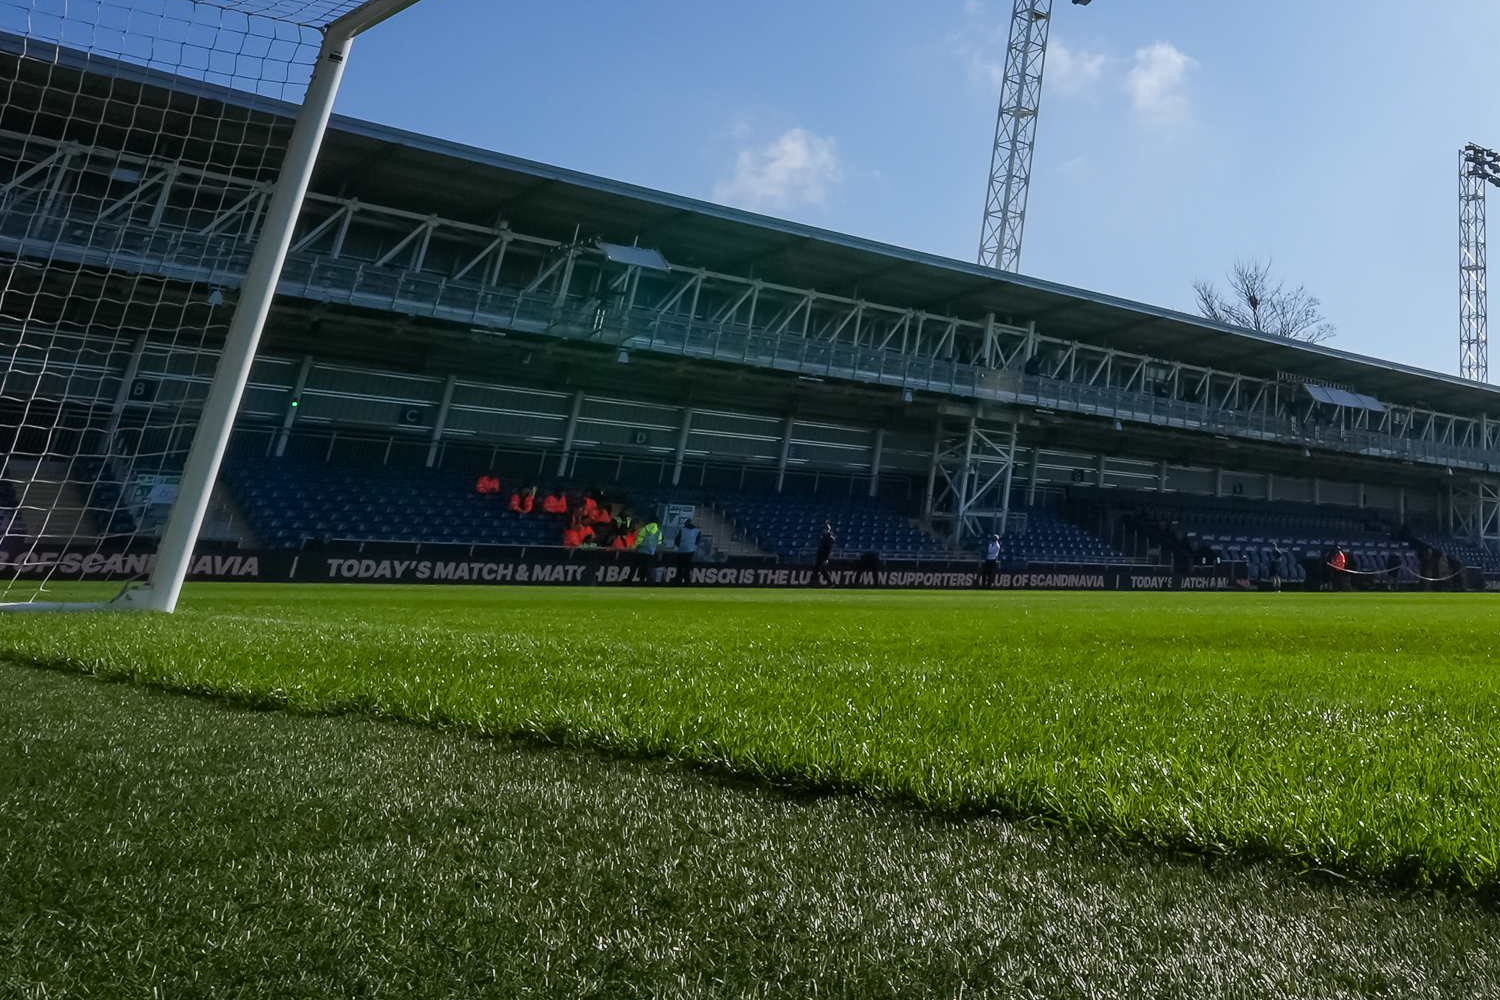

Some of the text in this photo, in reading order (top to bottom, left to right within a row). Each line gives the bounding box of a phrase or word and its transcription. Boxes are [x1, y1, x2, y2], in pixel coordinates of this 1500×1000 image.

[133, 382, 146, 396] B
[406, 409, 419, 422] C
[636, 432, 646, 443] D
[14, 552, 59, 573] OF
[327, 558, 432, 579] TODAY'S
[432, 561, 514, 581] MATCH
[514, 563, 530, 582] &
[605, 566, 648, 583] BAL
[738, 569, 755, 584] IS
[756, 569, 790, 585] THE
[888, 572, 978, 587] SUPPORTERS'
[1012, 574, 1029, 587] OF
[1029, 574, 1105, 588] SCANDINAVIA
